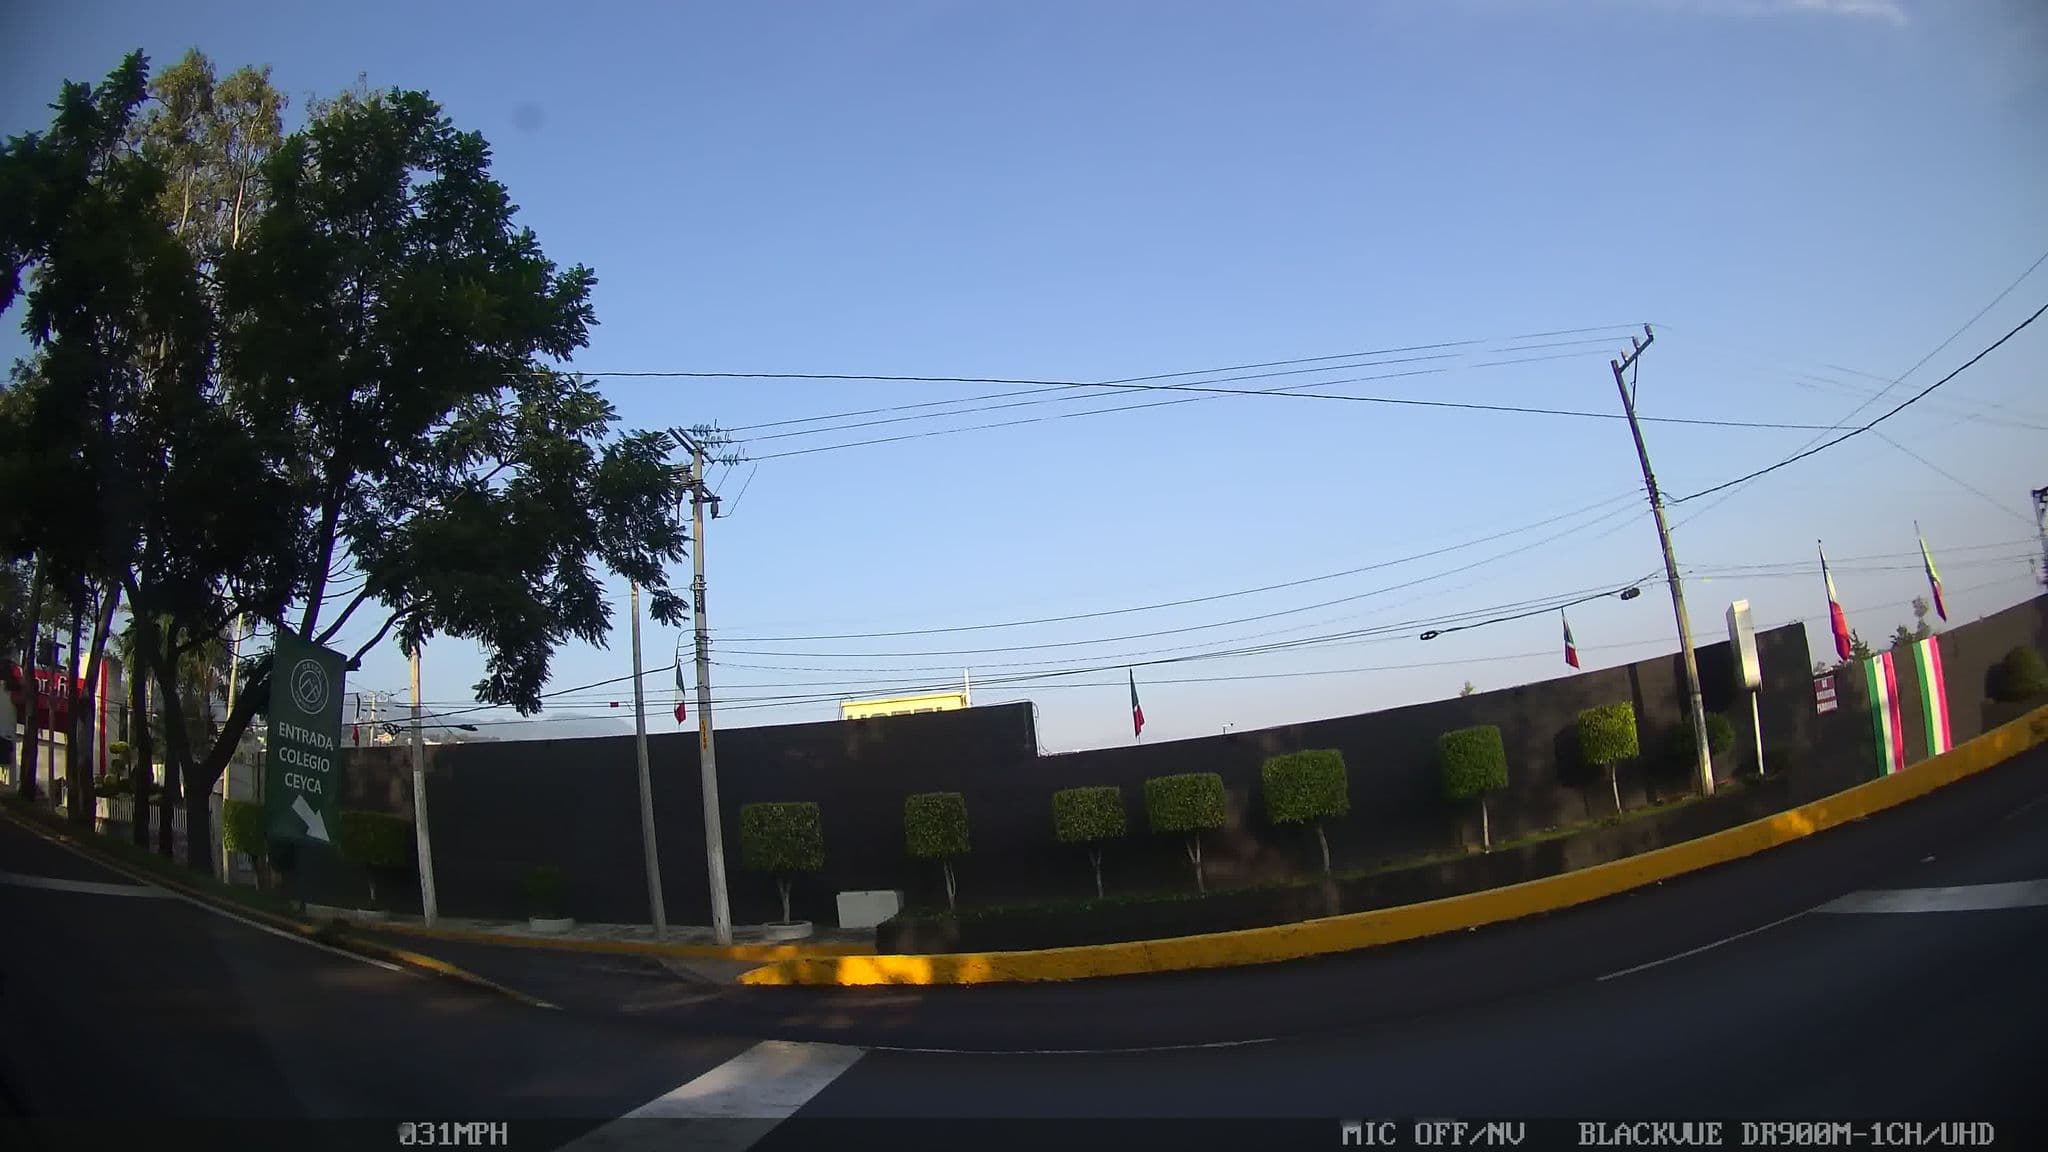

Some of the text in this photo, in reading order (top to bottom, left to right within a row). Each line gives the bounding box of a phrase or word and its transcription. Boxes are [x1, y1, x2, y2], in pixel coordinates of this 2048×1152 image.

[279, 721, 333, 751] ENTRADA
[279, 747, 330, 772] COLEGIO
[285, 773, 322, 794] CEYCA
